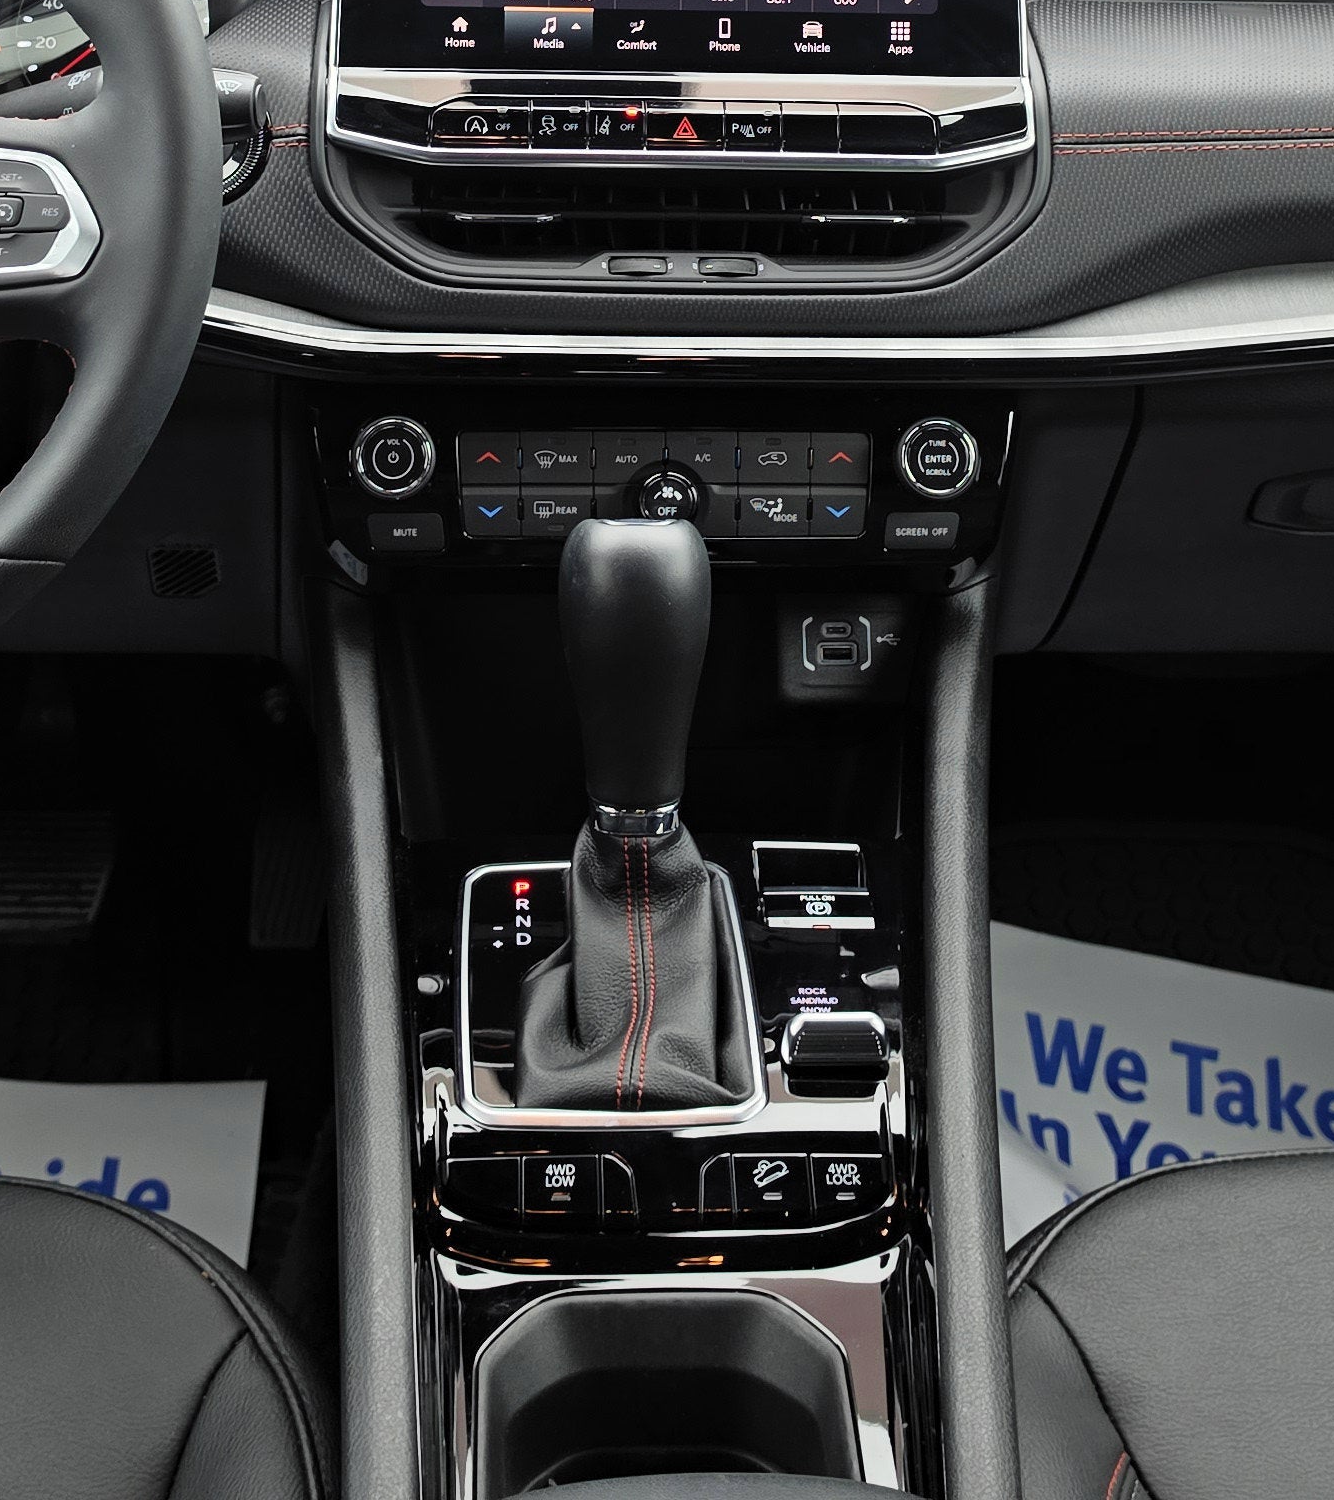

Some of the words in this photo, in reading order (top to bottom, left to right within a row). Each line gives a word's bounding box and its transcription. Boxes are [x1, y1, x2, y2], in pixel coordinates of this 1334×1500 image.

[35, 36, 57, 49] 20
[445, 37, 475, 48] Home
[533, 38, 564, 49] Media
[617, 39, 657, 51] Comfort
[709, 40, 741, 52] Phone
[794, 41, 831, 53] Vehicle
[888, 44, 914, 56] Apps
[496, 122, 511, 131] OFF
[563, 122, 578, 131] OFF
[620, 123, 635, 132] OFF
[757, 125, 772, 134] OFF
[41, 207, 59, 217] RES
[386, 438, 401, 446] VOL
[928, 440, 946, 448] TUNE
[558, 455, 578, 464] MAX
[615, 455, 638, 464] AUTO
[694, 452, 712, 463] A/C
[925, 454, 953, 464] ENTER
[925, 468, 951, 476] SCROLL
[555, 505, 578, 516] REAR
[657, 506, 677, 517] OFF
[773, 513, 798, 524] MODE
[393, 527, 418, 537] MUTE
[895, 527, 928, 538] SCREEN
[931, 527, 949, 537] OFF
[515, 881, 530, 896] P
[515, 898, 530, 911] R
[515, 915, 532, 928] N
[516, 932, 532, 946] D
[798, 987, 827, 995] ROCK
[1026, 1011, 1148, 1103] We
[545, 1163, 576, 1175] 4WD
[828, 1163, 857, 1175] 4WD
[545, 1175, 575, 1188] LOW
[826, 1174, 862, 1186] LOCK
